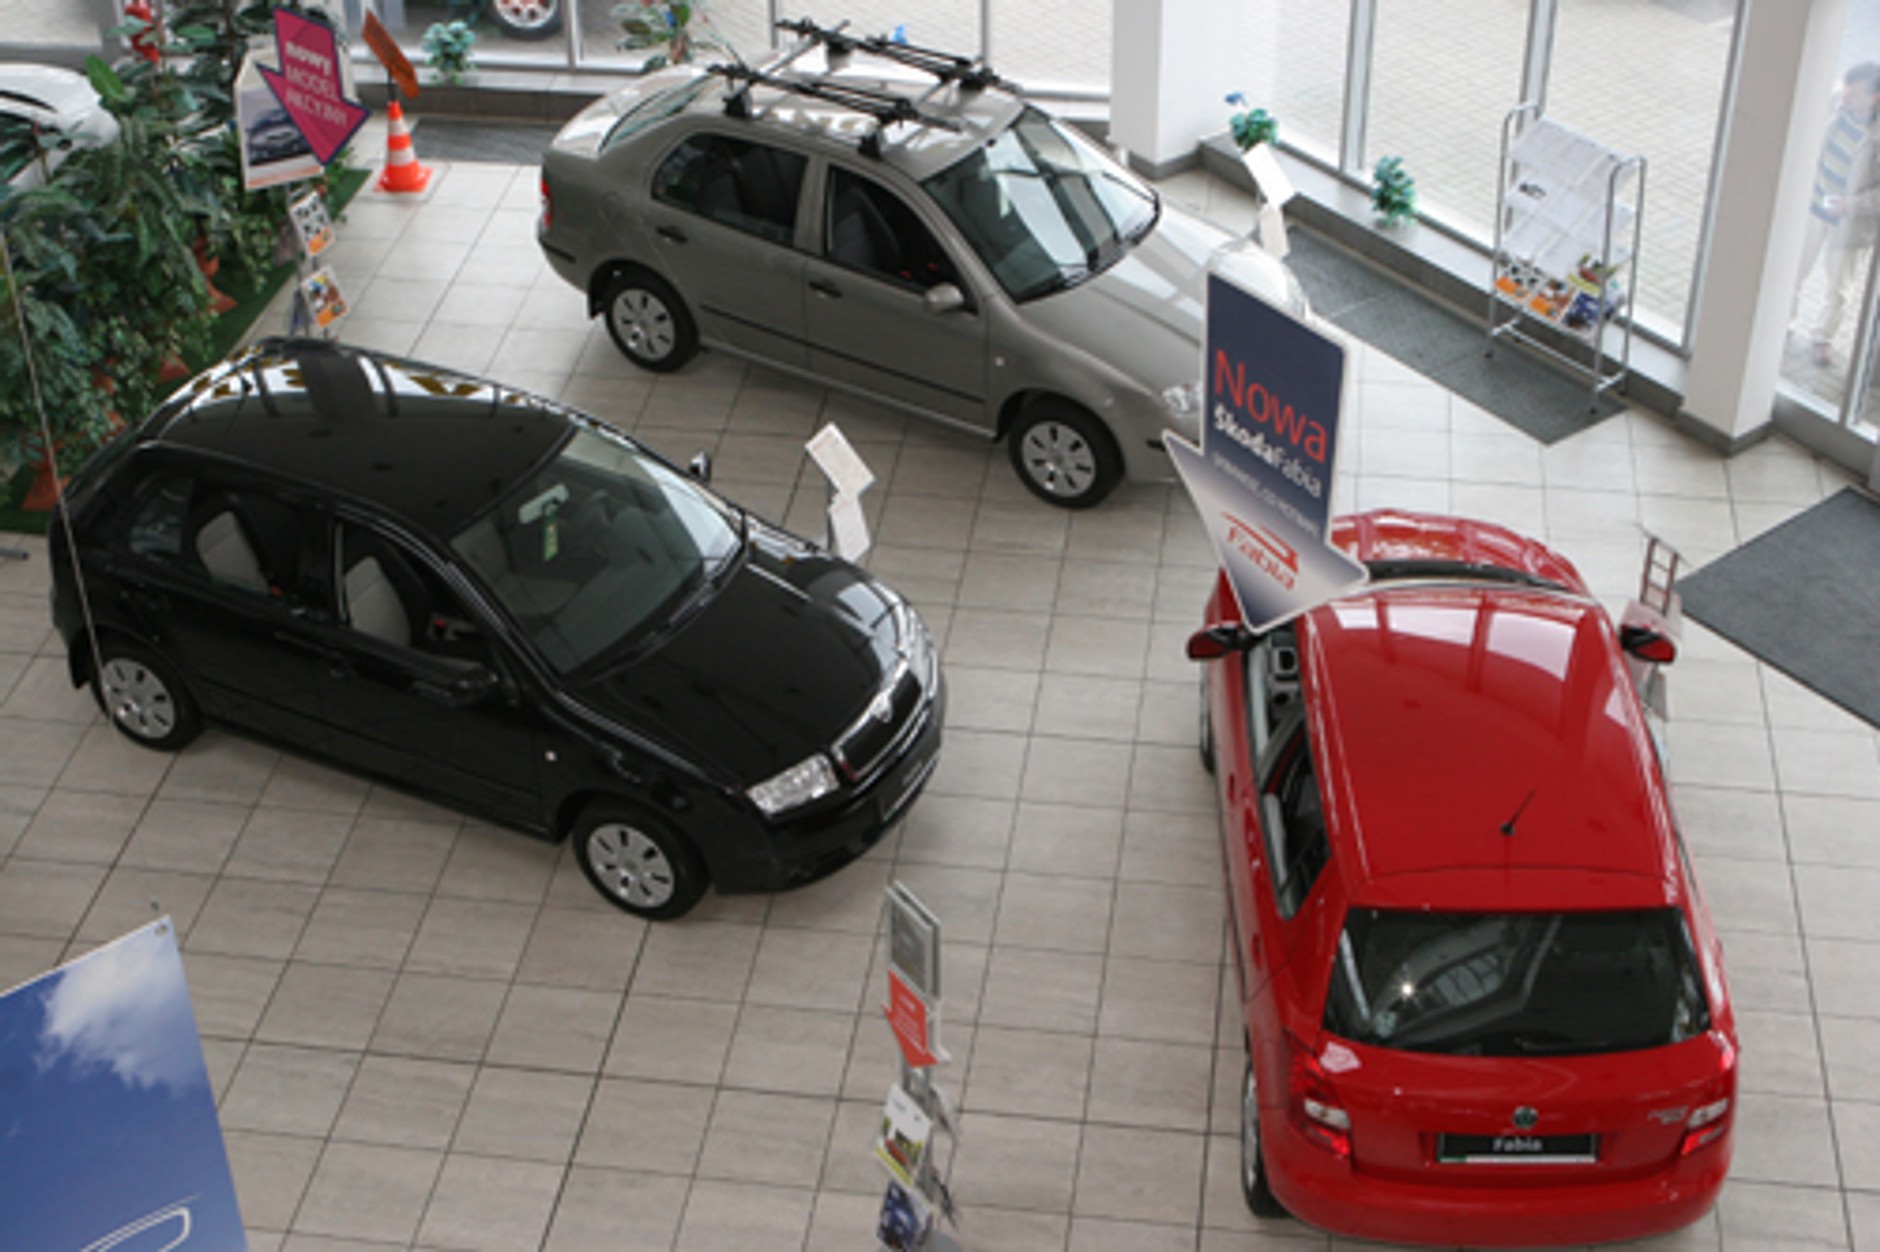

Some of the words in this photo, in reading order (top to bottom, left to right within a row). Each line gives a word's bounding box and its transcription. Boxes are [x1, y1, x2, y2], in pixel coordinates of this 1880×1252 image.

[1214, 348, 1328, 463] Nowa
[1226, 526, 1296, 592] Fabia
[1492, 1136, 1543, 1152] Fabia
